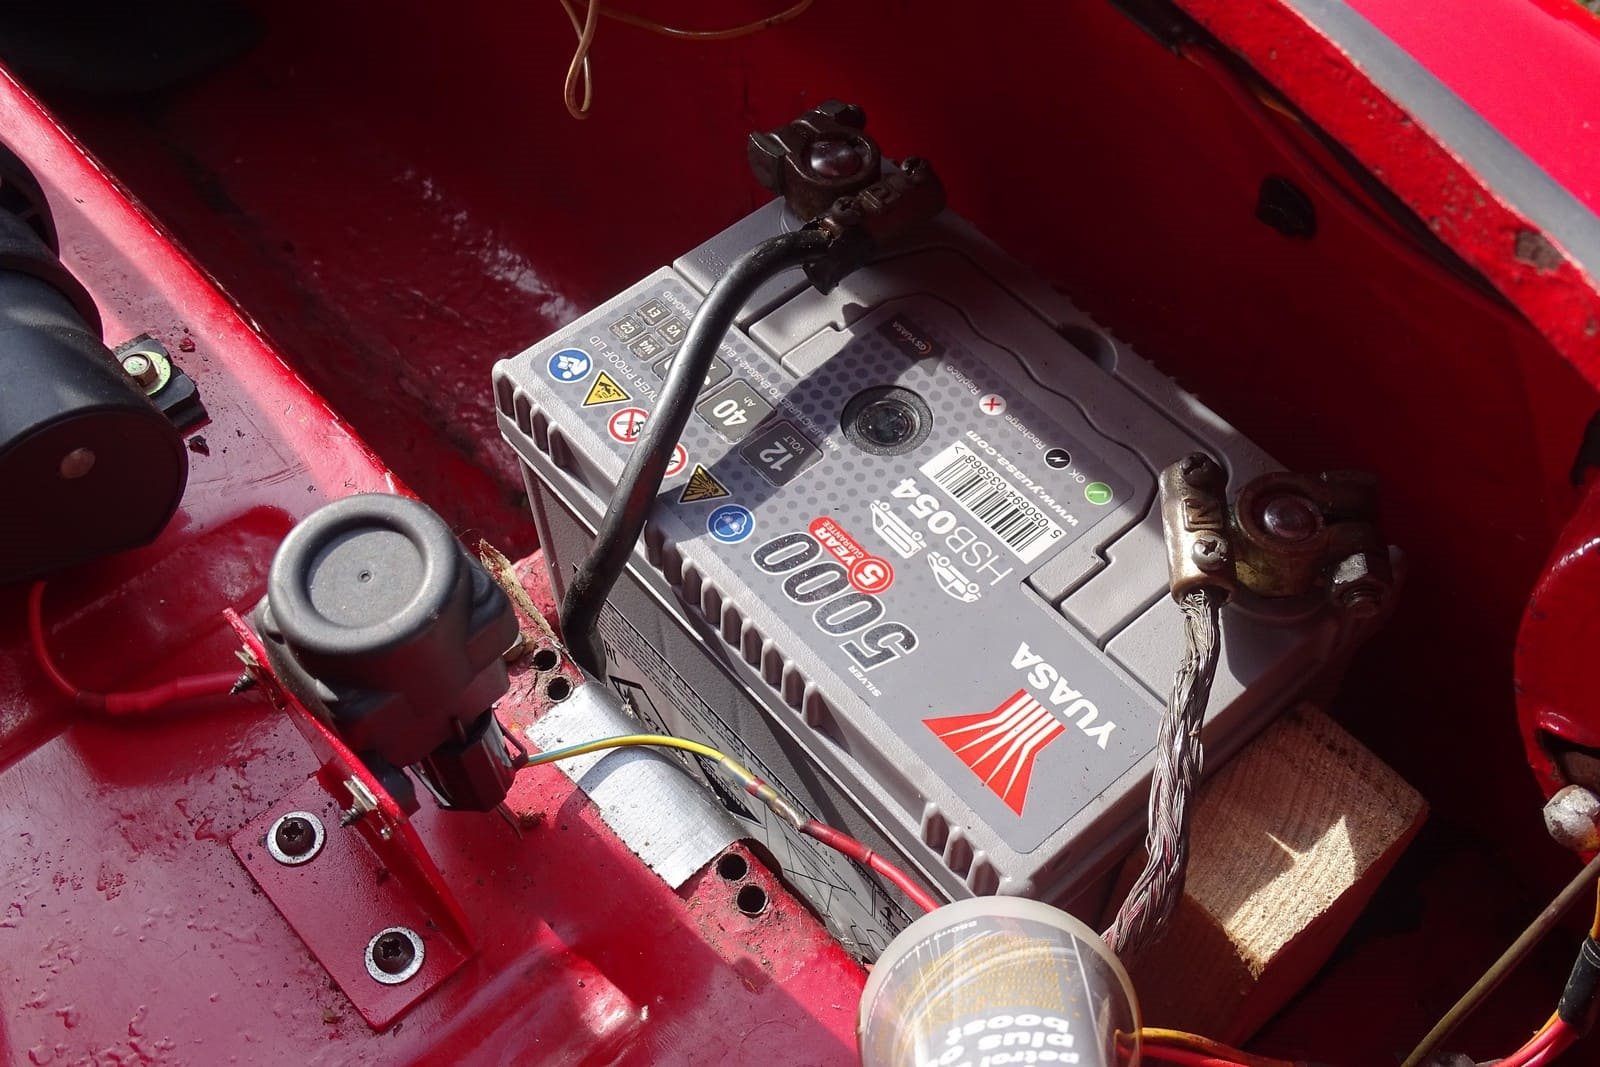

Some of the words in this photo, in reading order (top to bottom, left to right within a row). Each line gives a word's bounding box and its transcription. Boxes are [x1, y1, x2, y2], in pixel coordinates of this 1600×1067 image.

[645, 305, 662, 318] E1
[661, 289, 696, 319] TANDARD
[587, 334, 608, 352] LID
[619, 320, 635, 335] C2
[665, 323, 681, 338] V3
[638, 338, 656, 355] W4
[601, 349, 638, 379] PROOF
[944, 363, 982, 395] Replace
[743, 395, 757, 406] Ah
[766, 385, 781, 399] TO
[711, 397, 748, 425] 40
[777, 395, 841, 452] MANUFACTURED
[781, 433, 805, 455] VOLT
[1003, 412, 1047, 449] Recharge
[756, 439, 794, 474] 12
[963, 452, 1008, 492] 035968
[964, 428, 1079, 527] www.yuasa.com
[1066, 467, 1088, 485] OK
[1004, 489, 1050, 528] 050694
[813, 524, 856, 567] YEAR
[820, 518, 865, 558] GUARANTEE
[889, 475, 1014, 586] HSB054
[1049, 527, 1063, 540] 5
[749, 532, 919, 673] 5000
[846, 664, 883, 696] SILVER
[1008, 639, 1117, 751] YUASA
[944, 1012, 1069, 1046] boost
[976, 1029, 1074, 1051] plus
